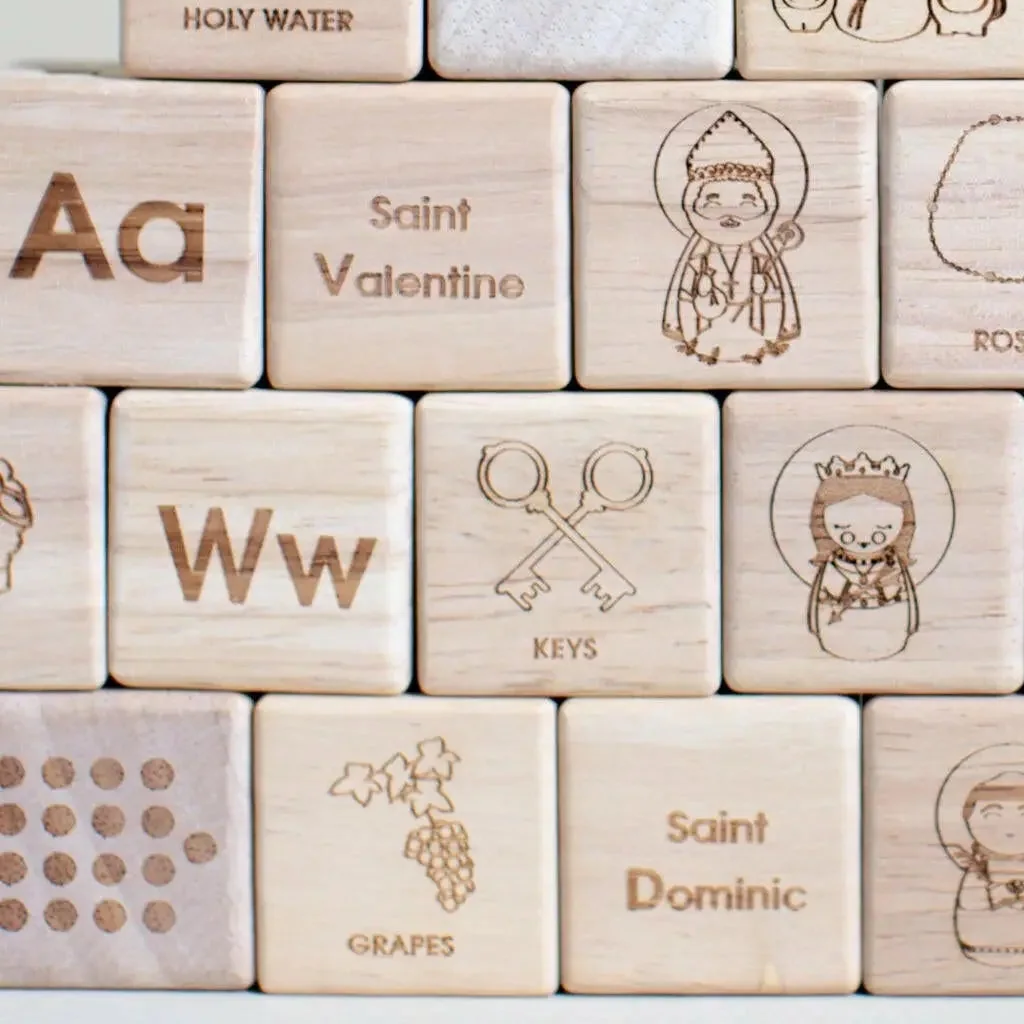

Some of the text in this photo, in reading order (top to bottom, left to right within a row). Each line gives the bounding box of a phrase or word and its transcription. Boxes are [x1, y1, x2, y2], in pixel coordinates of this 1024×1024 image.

[183, 7, 355, 33] HOLY WATER
[8, 171, 206, 284] Aa
[369, 195, 472, 232] Saint
[313, 252, 526, 300] Valentine
[156, 504, 378, 610] Ww
[532, 636, 598, 660] KEYS
[667, 810, 769, 845] Saint
[625, 867, 808, 913] Dominic
[346, 933, 456, 958] GRAPES
